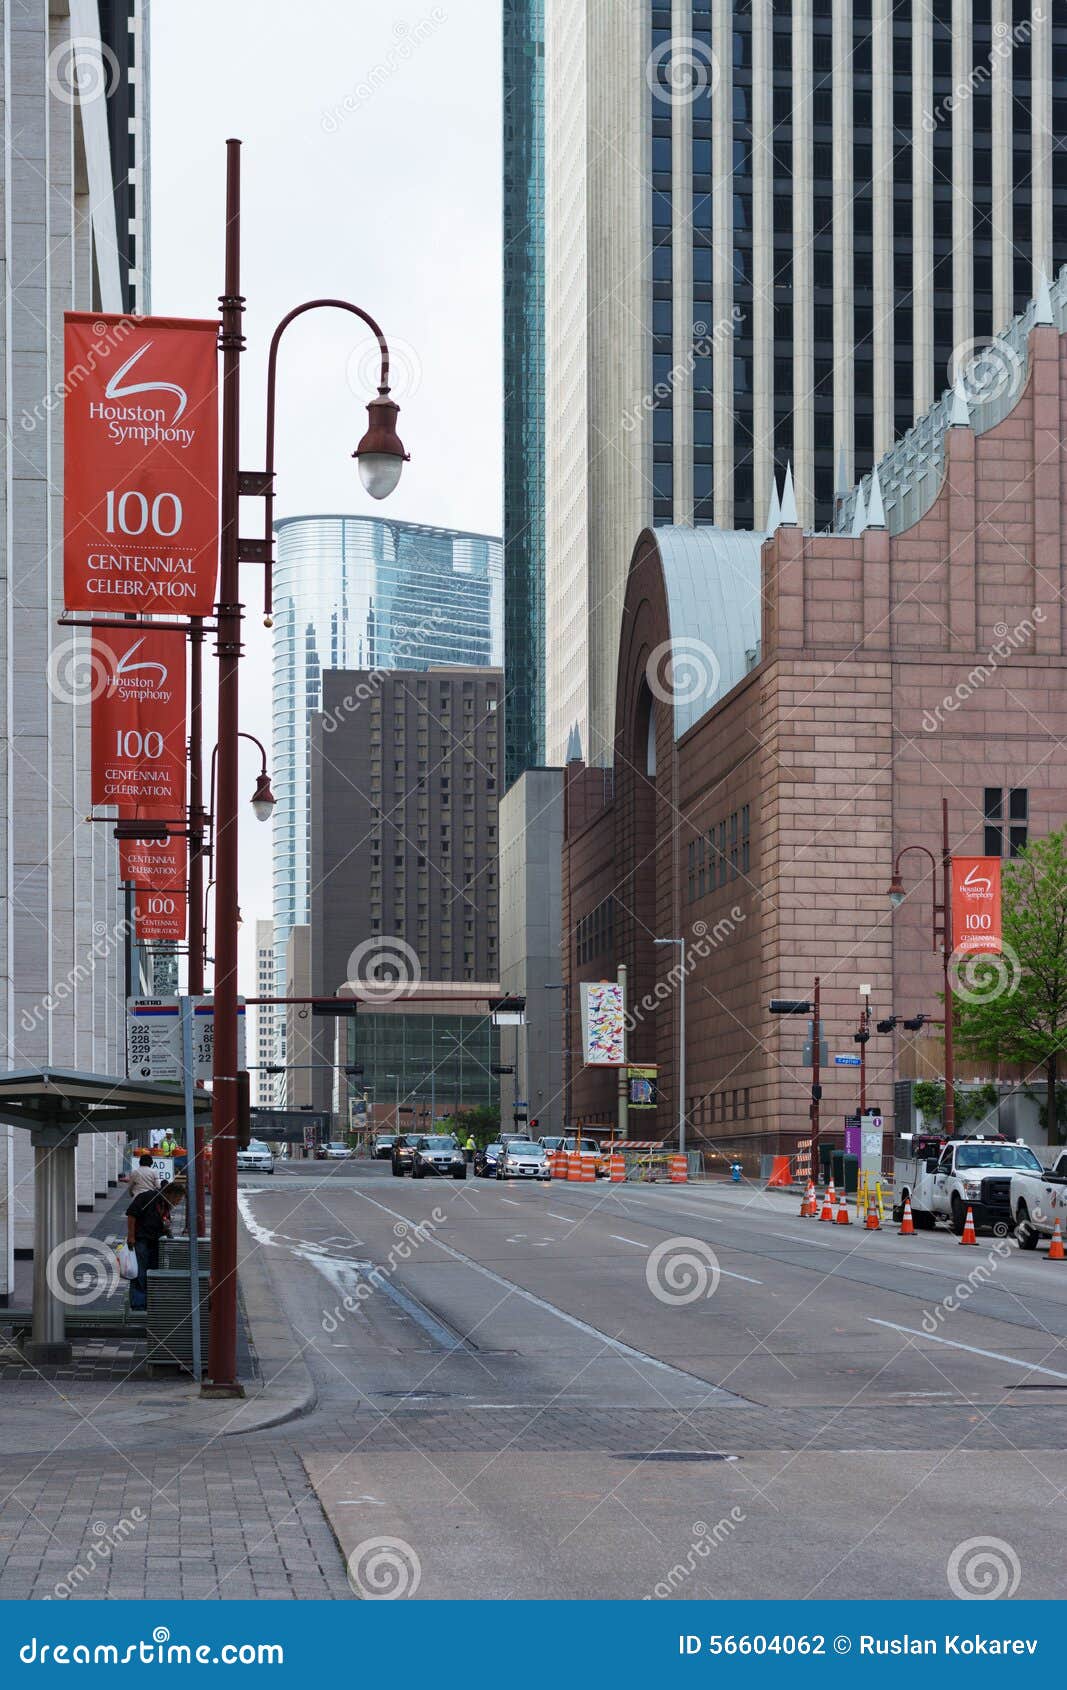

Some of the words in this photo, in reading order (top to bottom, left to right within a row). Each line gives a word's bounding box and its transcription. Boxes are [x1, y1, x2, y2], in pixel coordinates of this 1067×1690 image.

[89, 402, 165, 422] Houston
[108, 421, 195, 448] Symphony
[106, 491, 183, 536] 100
[87, 554, 196, 574] CENTENNIAL
[86, 578, 196, 597] CELEBRATION
[106, 675, 153, 688] Houston
[118, 687, 172, 704] Symphony
[116, 730, 164, 758] 100
[105, 769, 171, 782] CENTENNIAL
[104, 783, 172, 796] CELEBRATION
[128, 855, 176, 864] CENTENNIAL
[127, 866, 177, 875] CELEBRATION
[148, 898, 175, 914] 100
[966, 914, 991, 929] 100
[131, 1025, 150, 1034] 222
[131, 1036, 150, 1044] 228
[132, 1045, 150, 1053] 229
[132, 1055, 150, 1063] 274
